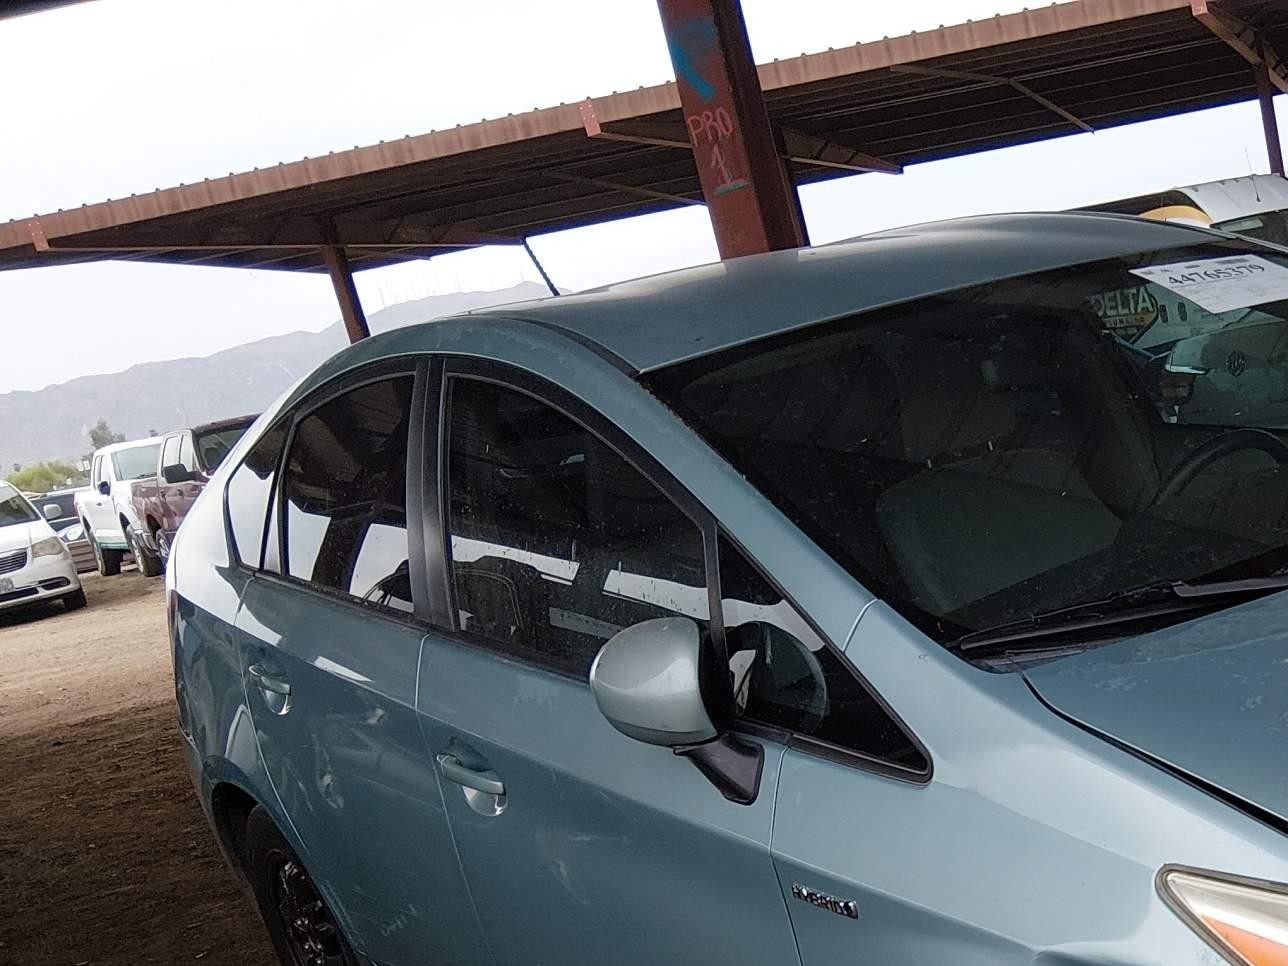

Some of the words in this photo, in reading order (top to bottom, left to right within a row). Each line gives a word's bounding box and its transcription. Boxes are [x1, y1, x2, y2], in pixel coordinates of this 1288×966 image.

[688, 106, 734, 148] PRO
[1168, 263, 1265, 285] 44765379
[1088, 286, 1154, 318] DELTA
